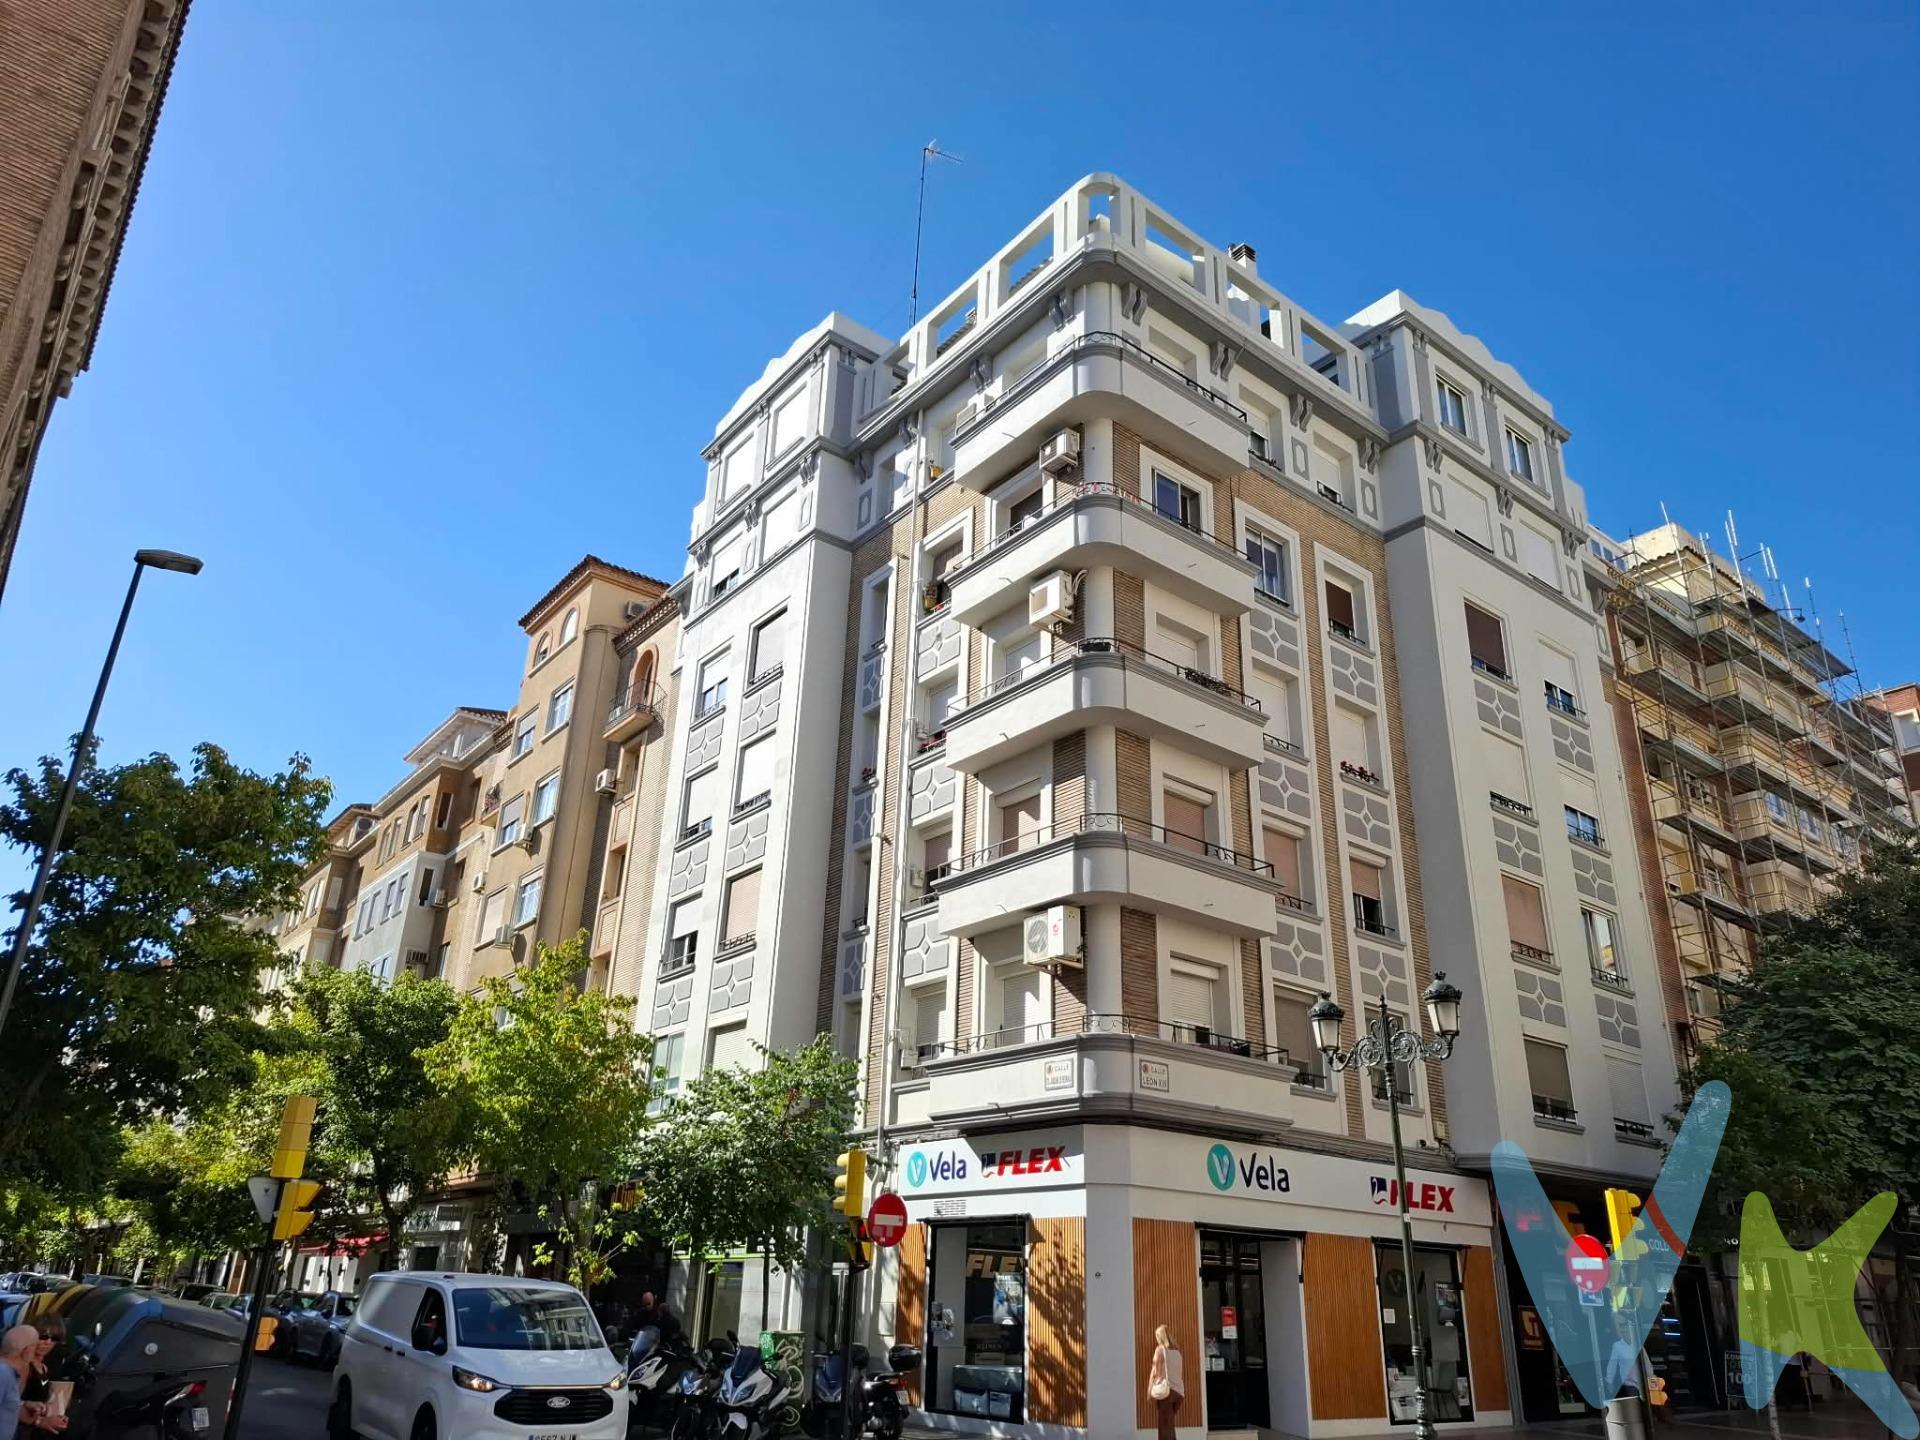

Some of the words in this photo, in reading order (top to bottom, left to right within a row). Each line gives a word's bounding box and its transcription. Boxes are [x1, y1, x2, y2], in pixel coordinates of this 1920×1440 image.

[929, 1150, 967, 1182] Vela
[996, 1145, 1066, 1177] FLEX
[1239, 1151, 1291, 1193] Vela
[965, 1254, 1025, 1279] FLE
